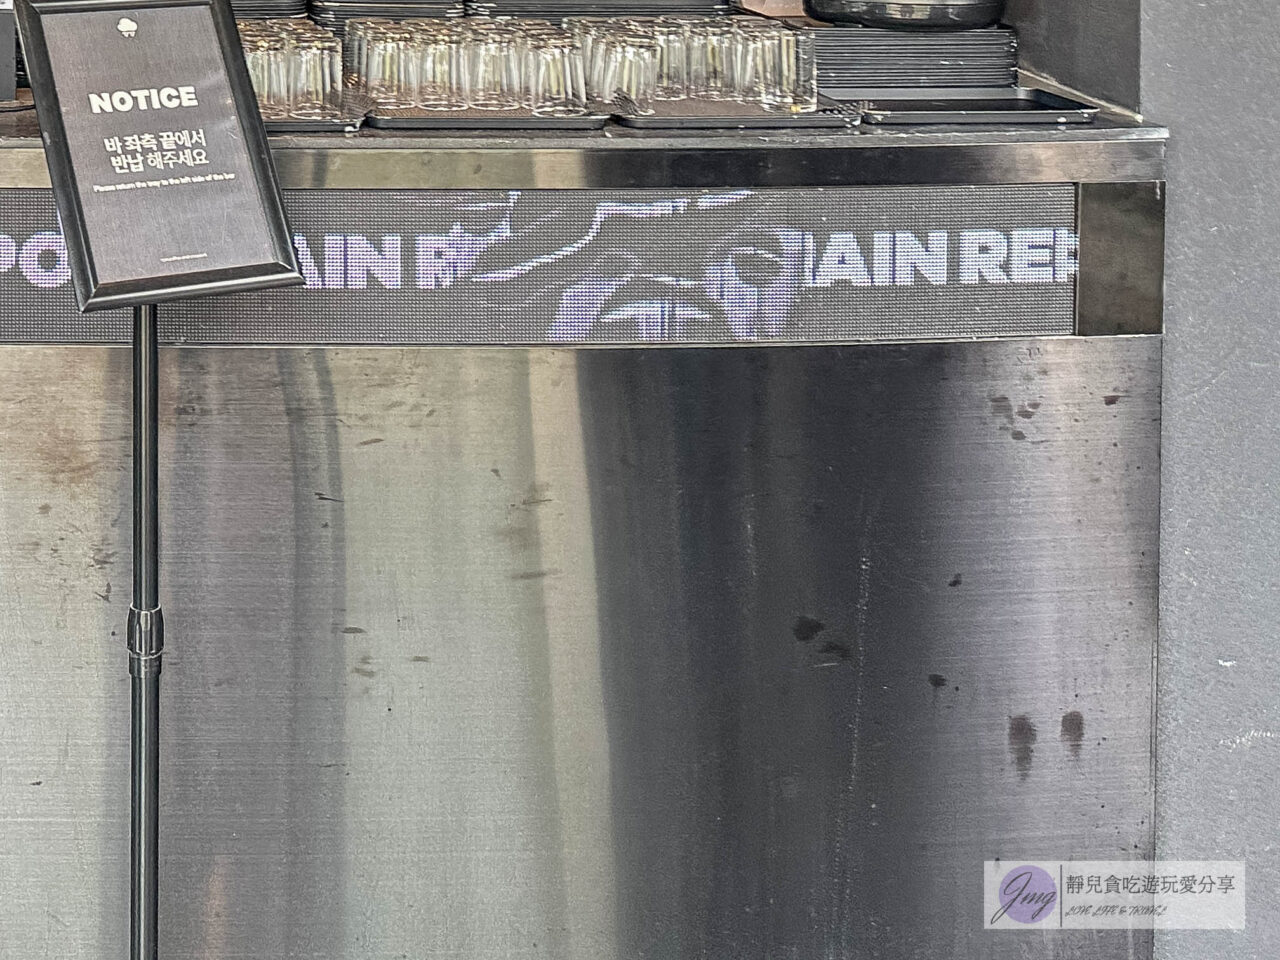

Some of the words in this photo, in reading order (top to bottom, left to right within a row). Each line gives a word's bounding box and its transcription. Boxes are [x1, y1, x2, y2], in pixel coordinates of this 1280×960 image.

[88, 86, 198, 114] NOTICE
[103, 136, 123, 154] 바
[123, 133, 158, 152] 좌측
[158, 128, 207, 150] 끝에서
[110, 152, 145, 174] 반납
[145, 148, 210, 170] 해주세요
